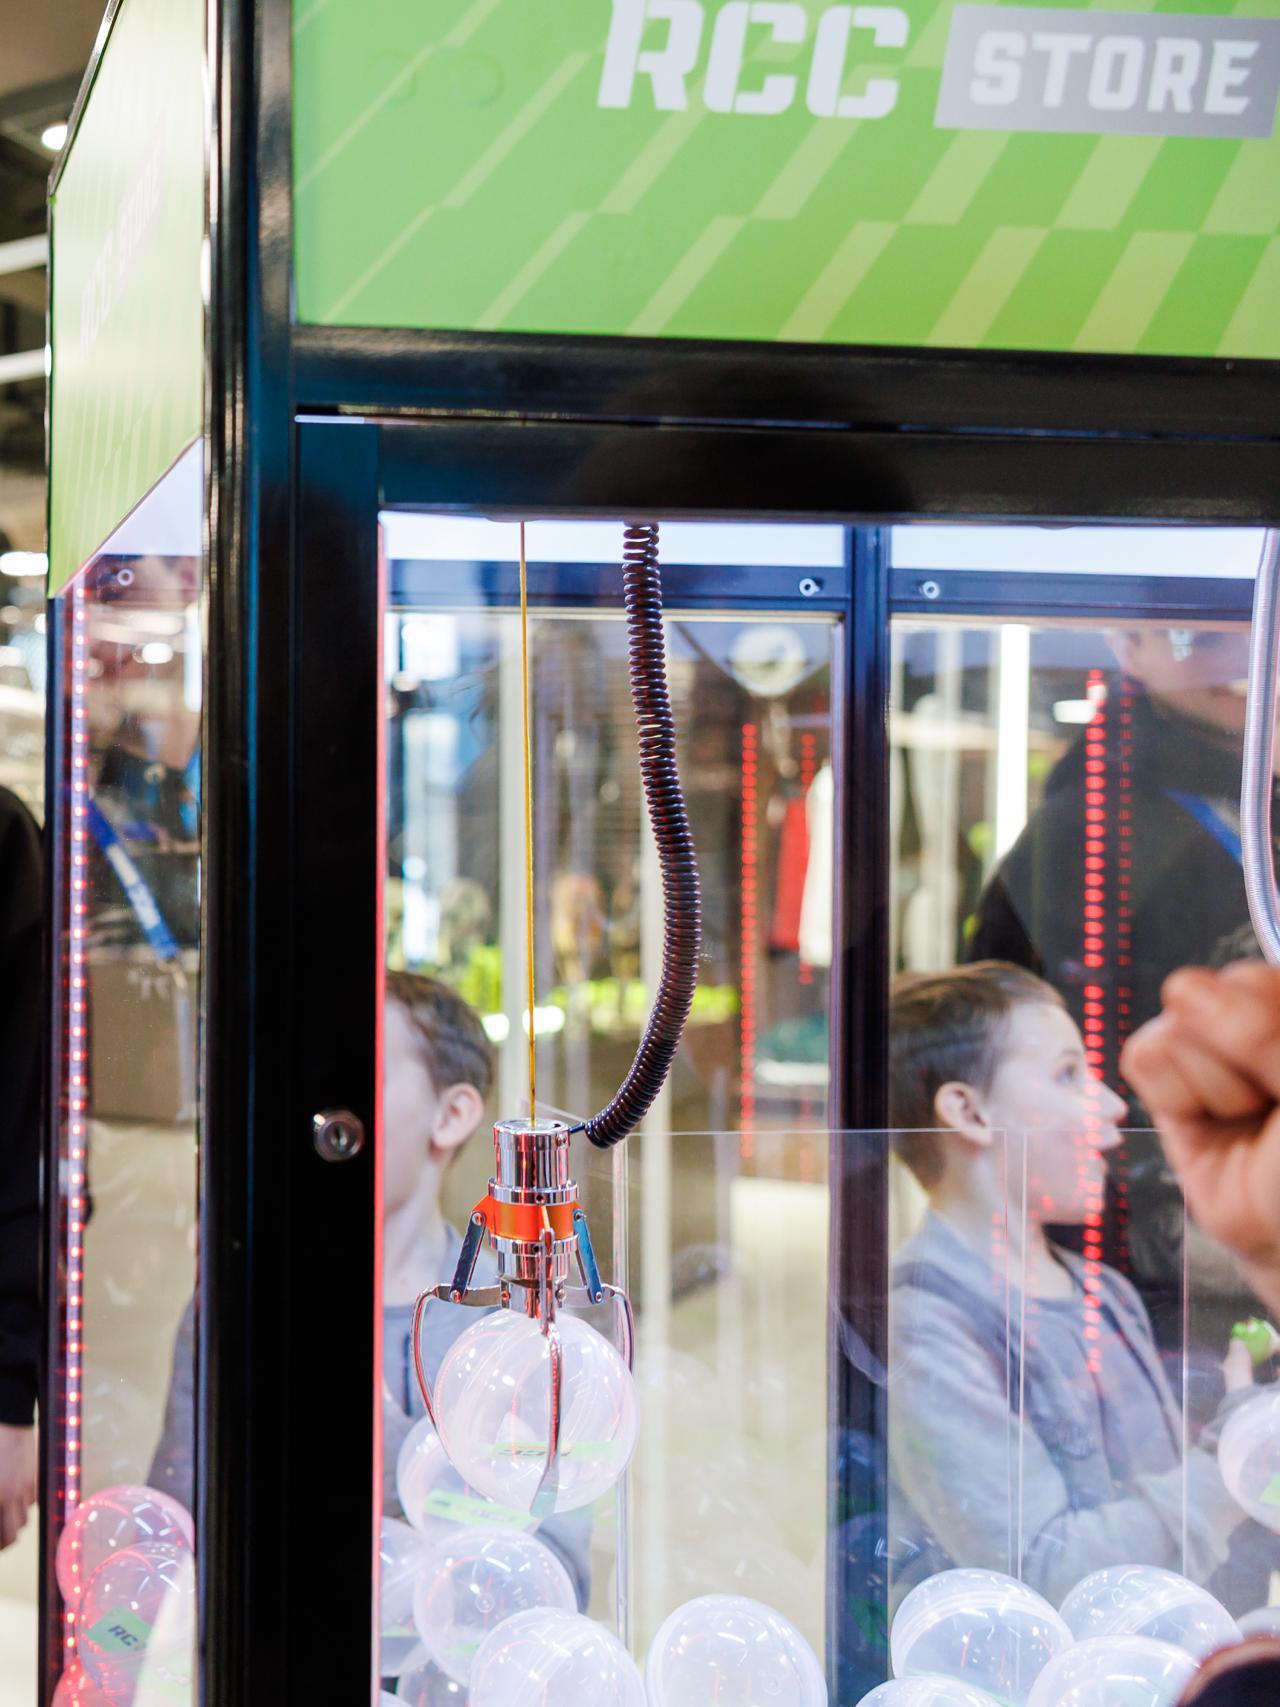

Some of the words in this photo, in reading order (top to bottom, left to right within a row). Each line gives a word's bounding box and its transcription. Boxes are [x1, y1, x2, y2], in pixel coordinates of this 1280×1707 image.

[597, 0, 910, 119] RCC
[969, 31, 1261, 115] STORE
[108, 1624, 143, 1650] RC
